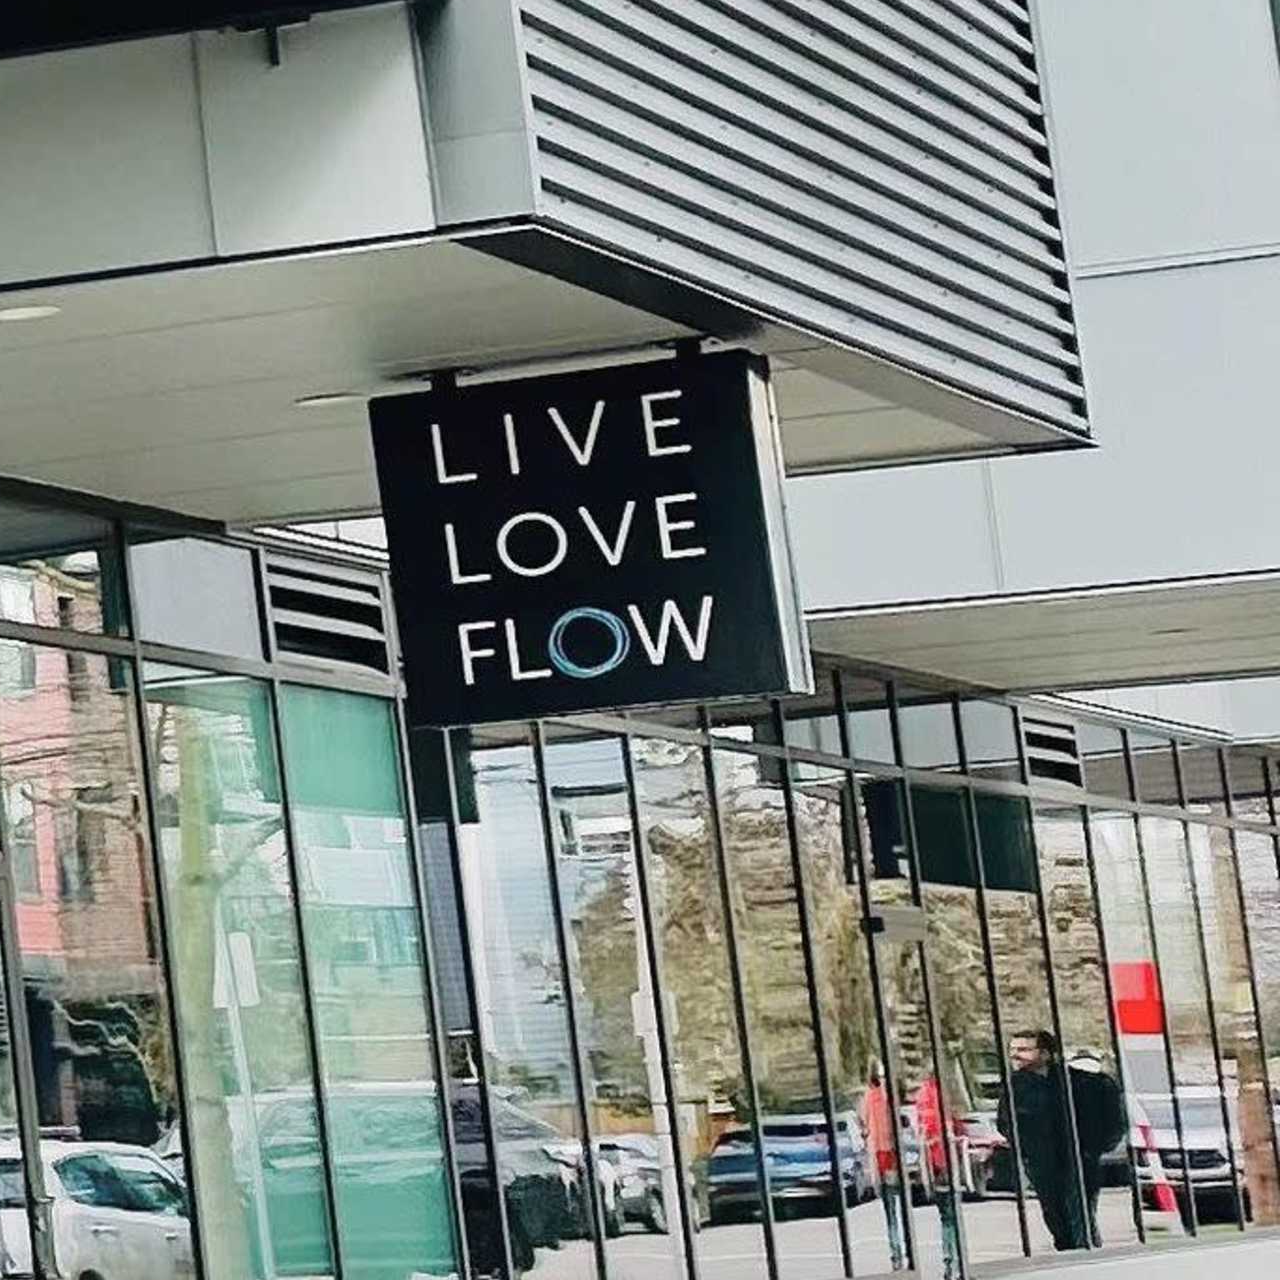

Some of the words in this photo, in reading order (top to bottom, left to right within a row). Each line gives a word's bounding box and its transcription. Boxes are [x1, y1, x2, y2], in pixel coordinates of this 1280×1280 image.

[430, 389, 693, 484] LIVE
[444, 492, 707, 585] LOVE
[458, 595, 714, 686] FLOW
